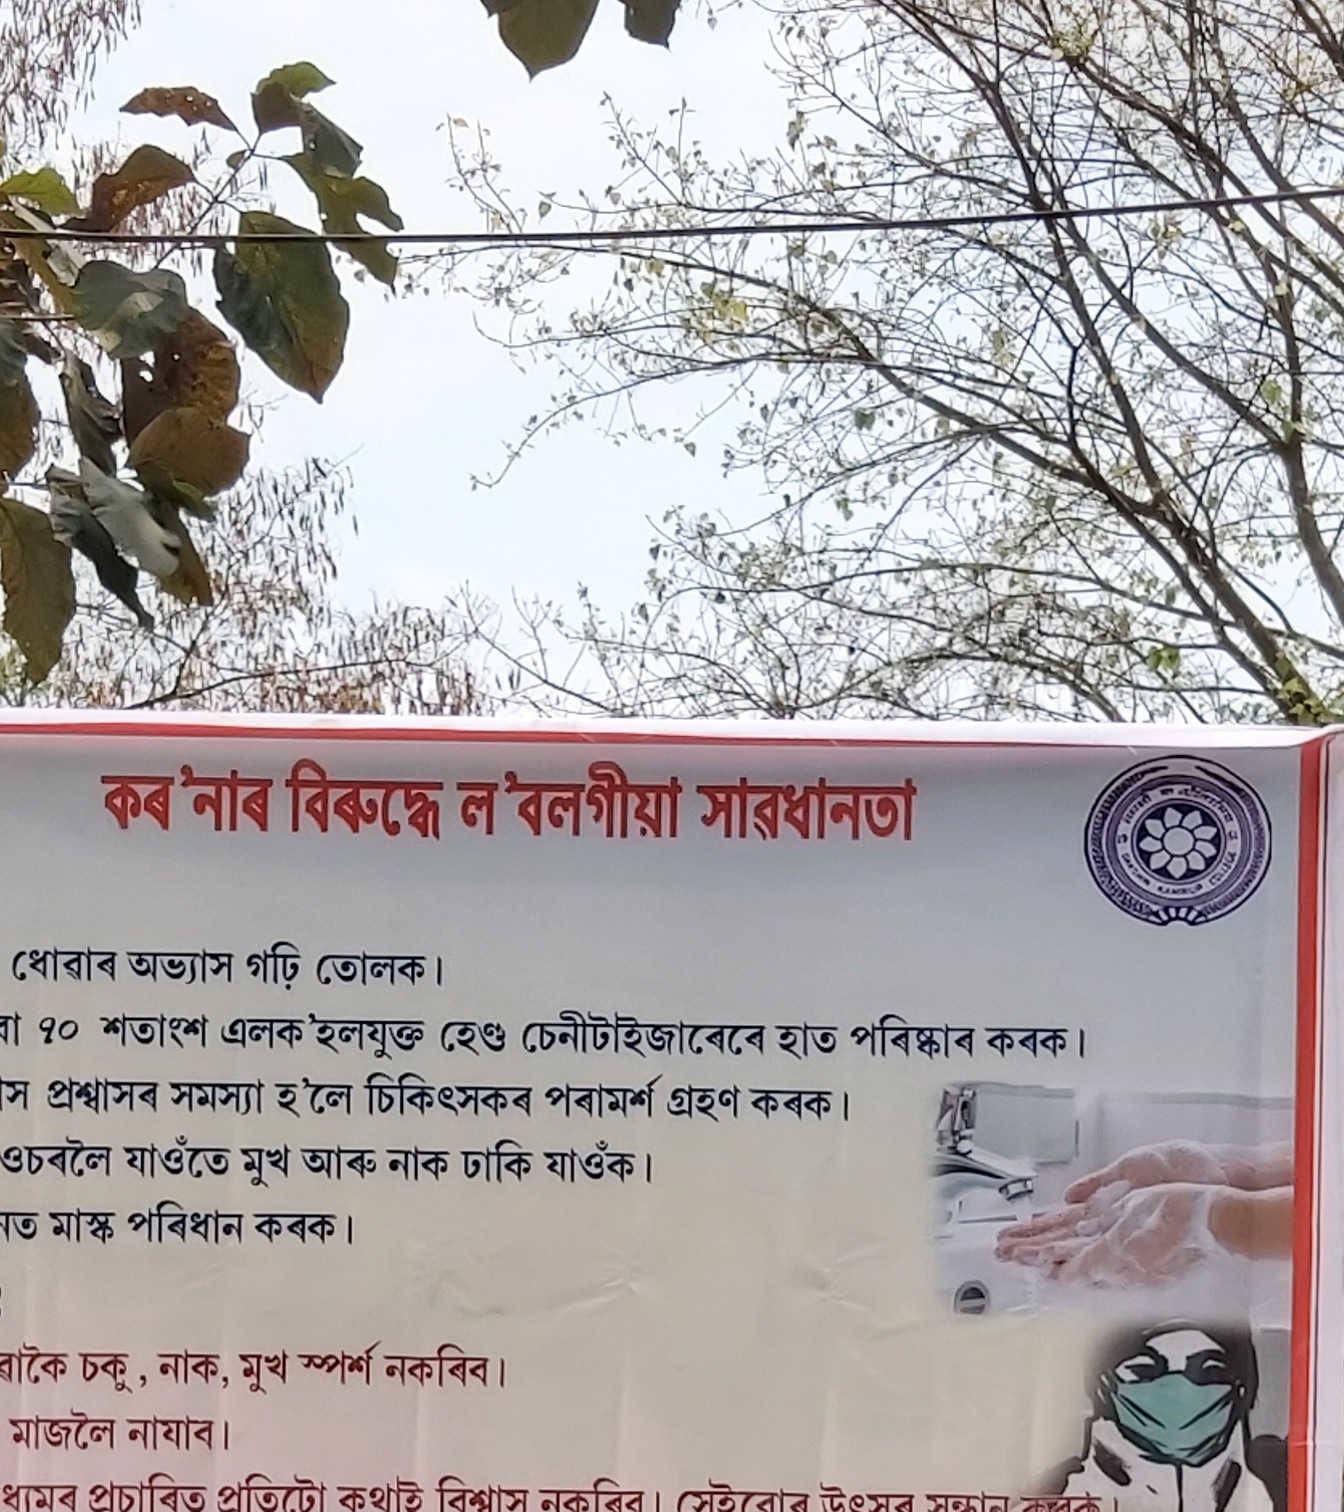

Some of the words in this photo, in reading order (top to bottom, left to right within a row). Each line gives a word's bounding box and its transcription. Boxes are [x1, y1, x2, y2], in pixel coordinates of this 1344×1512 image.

[284, 757, 445, 841] বিৰুদ্ধে
[11, 945, 119, 983] ধোৱাৰ
[245, 940, 303, 992] গঢ়ি
[38, 1016, 80, 1045] ৭০
[98, 1012, 211, 1050] শতাংশ
[773, 1021, 840, 1061] হাত
[849, 1018, 977, 1061] পৰিষ্কাৰ
[46, 1076, 161, 1116] প্ৰশ্বাসৰ
[167, 1077, 266, 1117] সমস্যা
[362, 1075, 534, 1118] চিকিৎসকৰ
[544, 1076, 663, 1119] পৰামৰ্শ
[666, 1083, 743, 1123] গ্ৰহণ
[121, 1134, 232, 1180] যাওঁতে
[238, 1142, 293, 1189] মুখ
[299, 1143, 377, 1181] আৰু
[384, 1144, 452, 1182] নাক
[459, 1138, 535, 1185] ঢাকি
[47, 1207, 118, 1245] মাস্ক
[126, 1202, 245, 1245] পৰিধান
[156, 1348, 229, 1390] নাক,
[237, 1348, 290, 1396] মুখ
[295, 1342, 381, 1387] স্পৰ্শ
[7, 1407, 117, 1451] মাজলৈ
